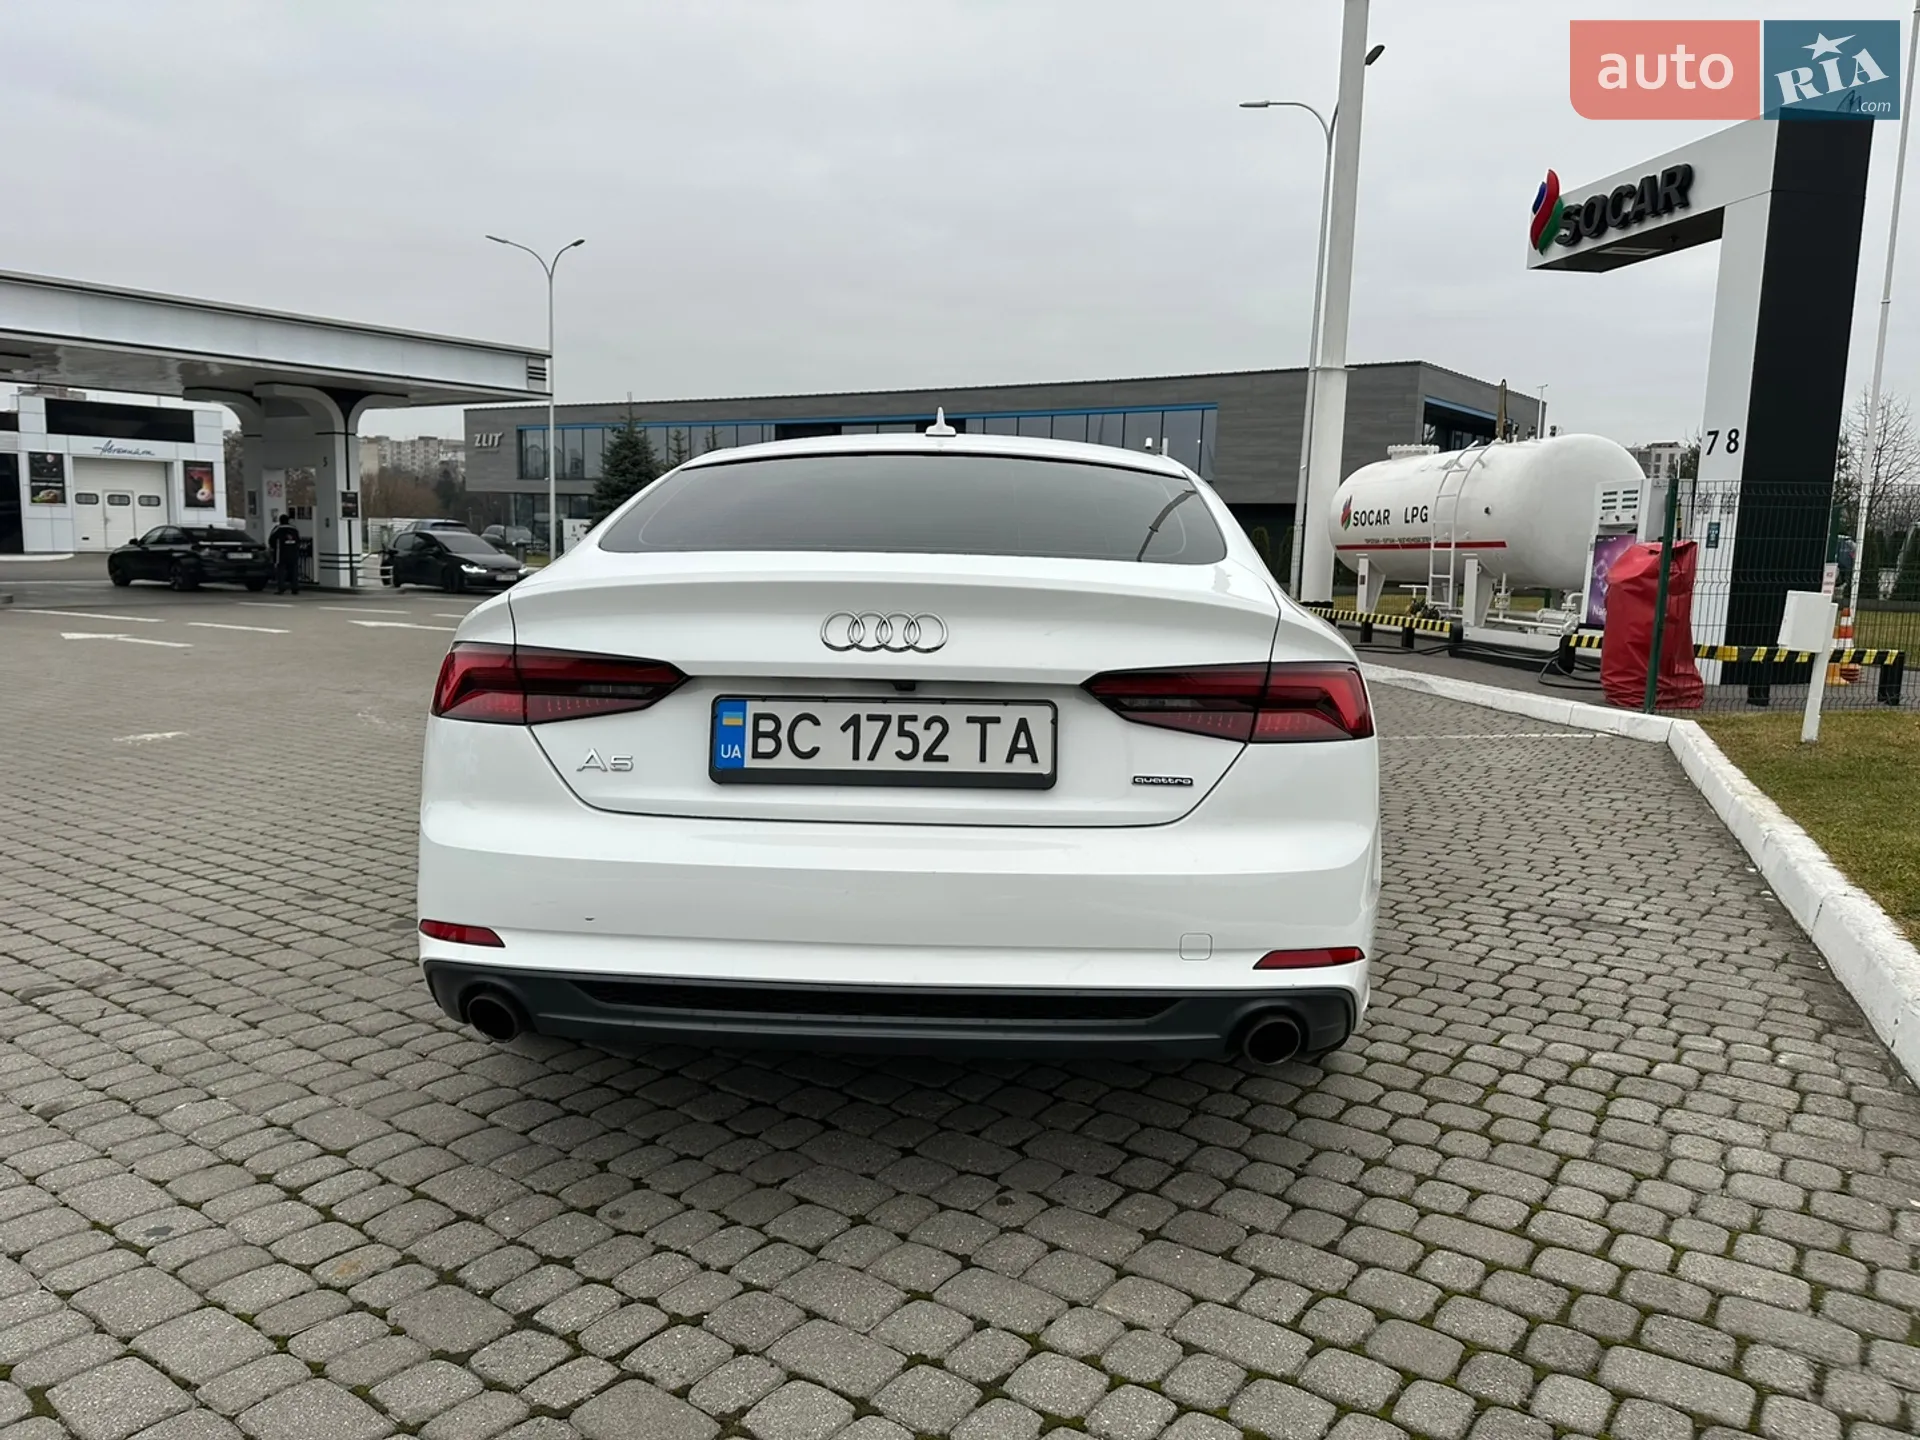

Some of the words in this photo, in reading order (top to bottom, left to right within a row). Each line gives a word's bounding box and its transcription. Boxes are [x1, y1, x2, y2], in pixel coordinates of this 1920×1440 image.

[1554, 163, 1694, 247] SOCAR
[1352, 508, 1391, 527] SOCAR
[1404, 505, 1429, 524] LPG
[751, 712, 822, 760] BC
[840, 713, 950, 763] 1752
[966, 715, 1039, 764] TA
[576, 748, 635, 772] A5
[720, 744, 742, 759] UA
[1134, 777, 1192, 785] quattro
